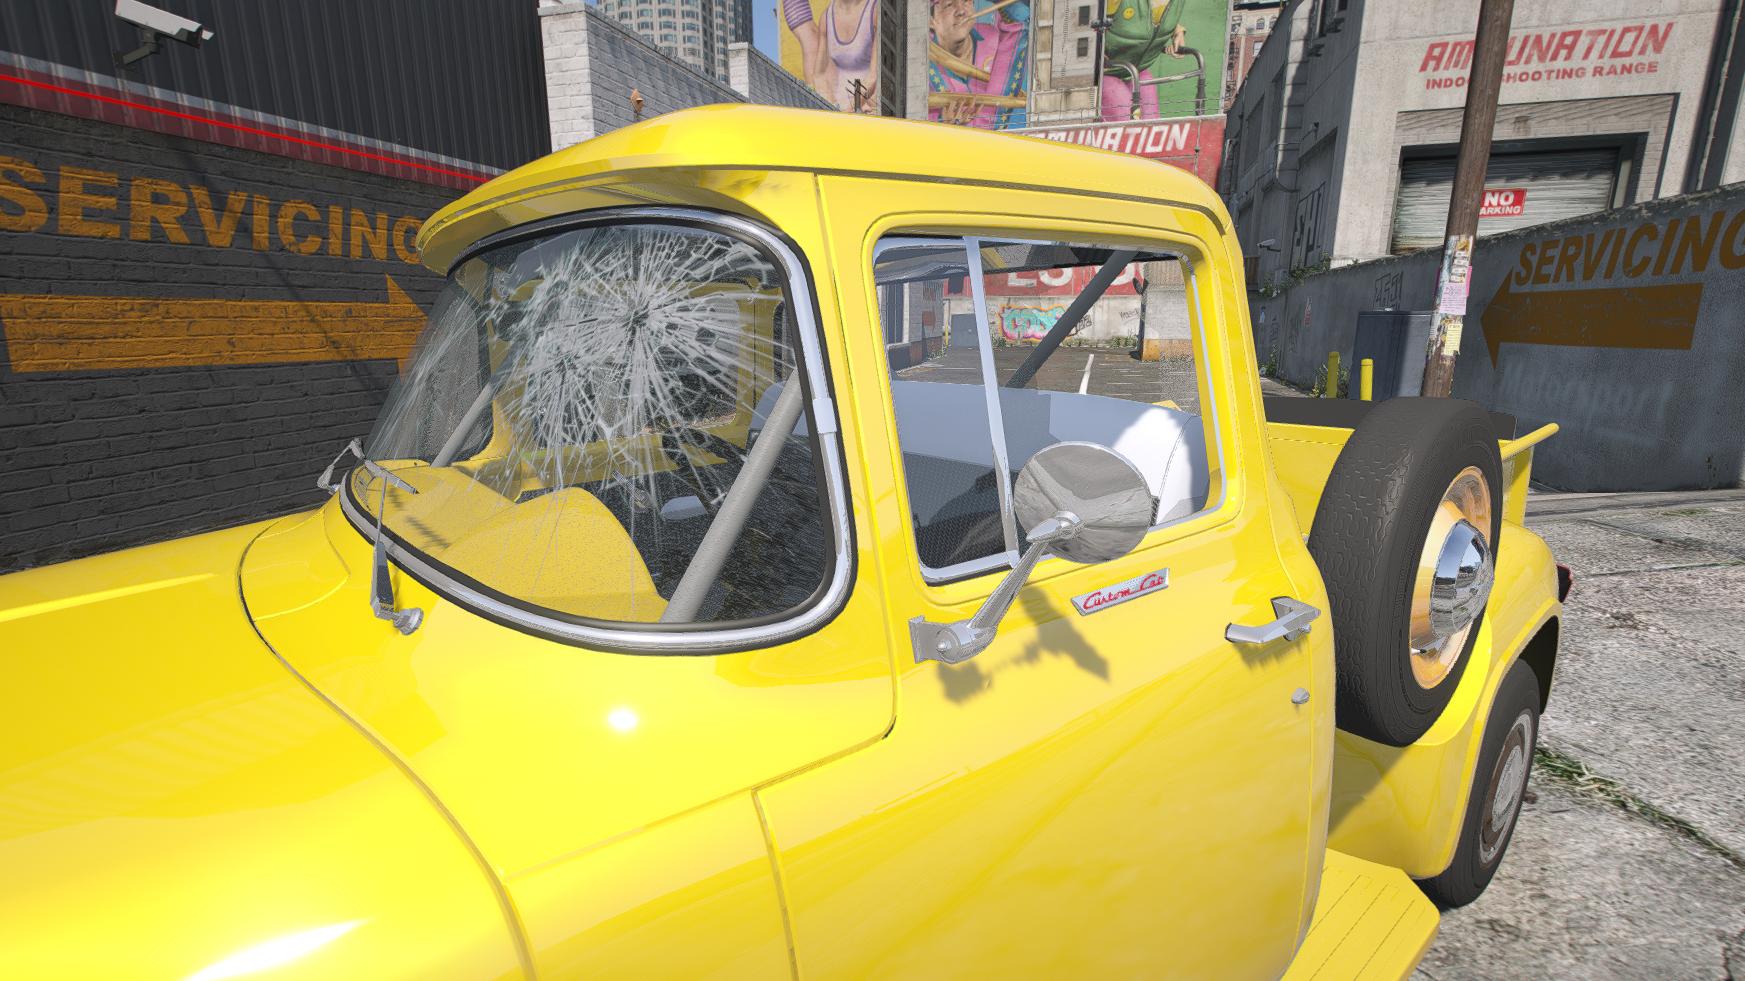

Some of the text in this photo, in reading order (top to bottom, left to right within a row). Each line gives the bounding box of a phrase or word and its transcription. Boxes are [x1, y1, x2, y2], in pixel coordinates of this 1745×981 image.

[1419, 22, 1675, 72] AMUNATION
[1426, 61, 1659, 90] INDO HOOTING RANGE
[1480, 205, 1521, 215] ARKING
[1483, 191, 1515, 207] NO
